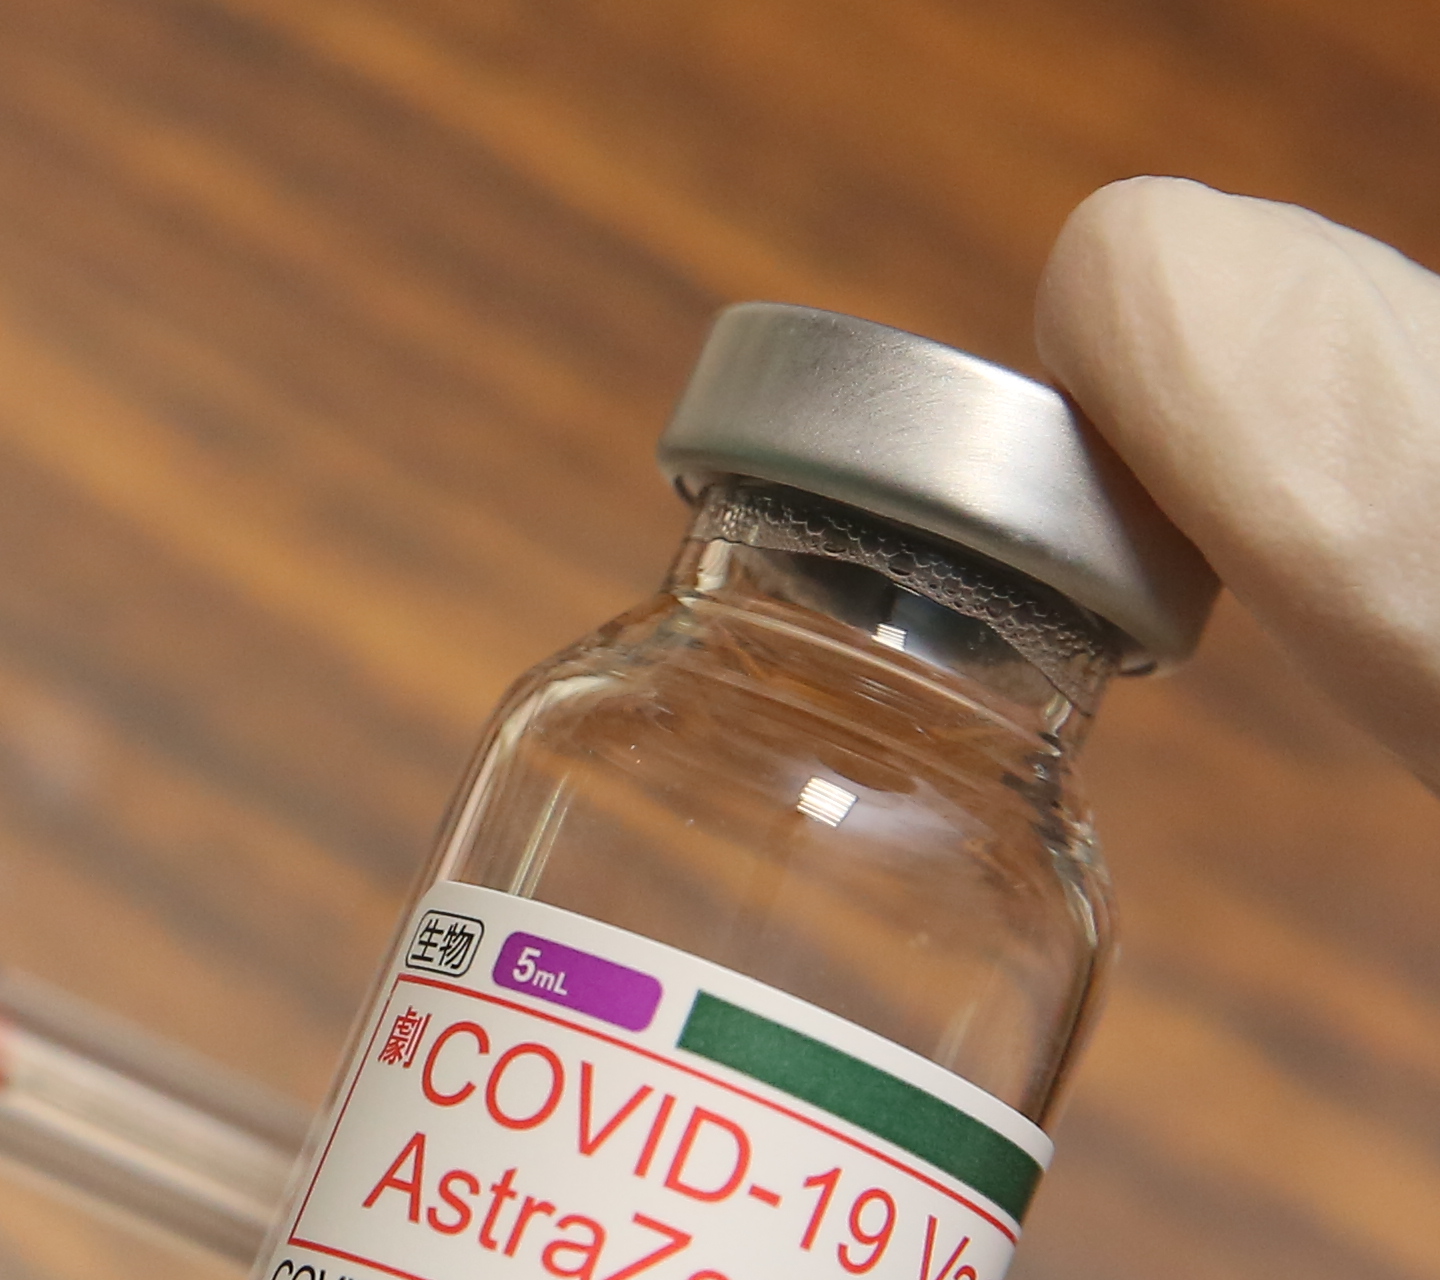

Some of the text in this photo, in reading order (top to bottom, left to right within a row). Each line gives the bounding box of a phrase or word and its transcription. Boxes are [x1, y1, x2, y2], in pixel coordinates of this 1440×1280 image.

[410, 919, 476, 971] 生物
[511, 946, 569, 997] 5mL
[377, 1005, 433, 1069] 劇
[421, 1020, 898, 1276] COVID-19
